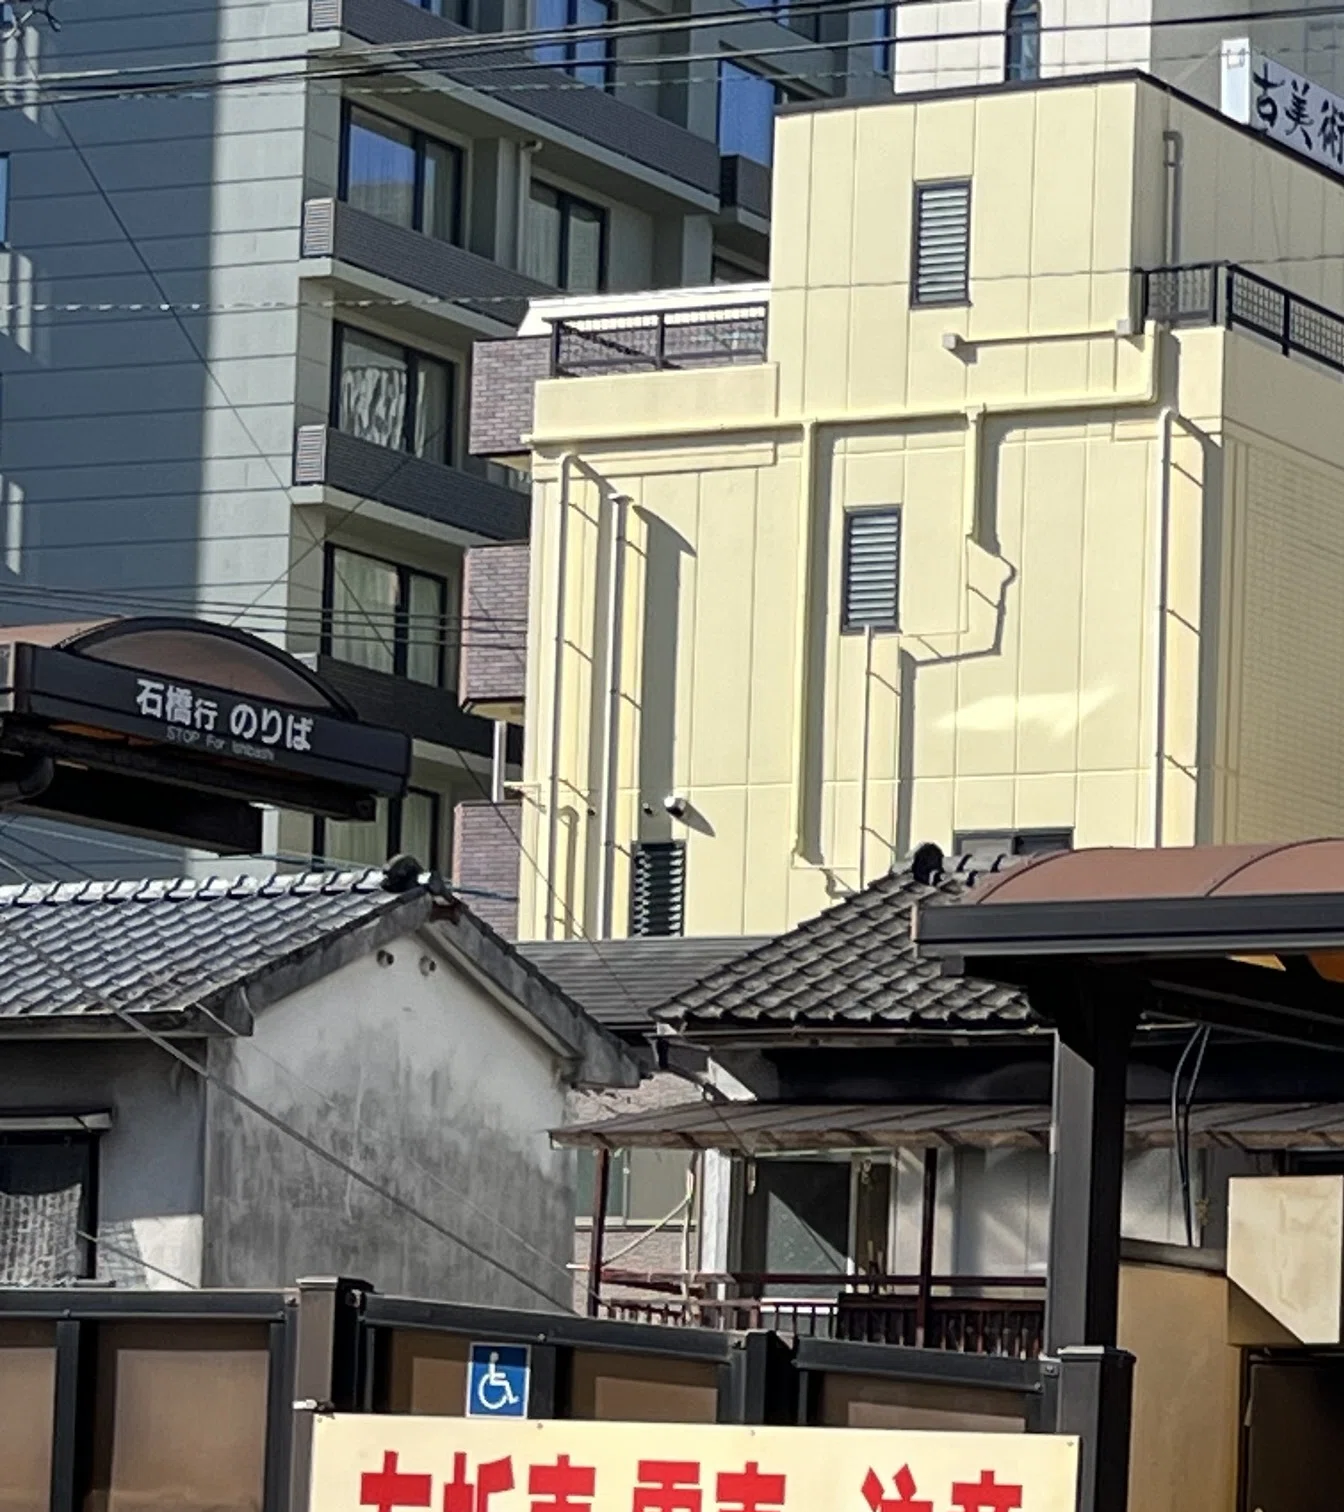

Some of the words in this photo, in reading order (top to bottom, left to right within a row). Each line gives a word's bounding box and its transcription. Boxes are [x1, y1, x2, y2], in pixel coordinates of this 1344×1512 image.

[136, 678, 218, 731] 石橋行
[230, 703, 314, 751] のりば
[167, 726, 200, 744] STOP
